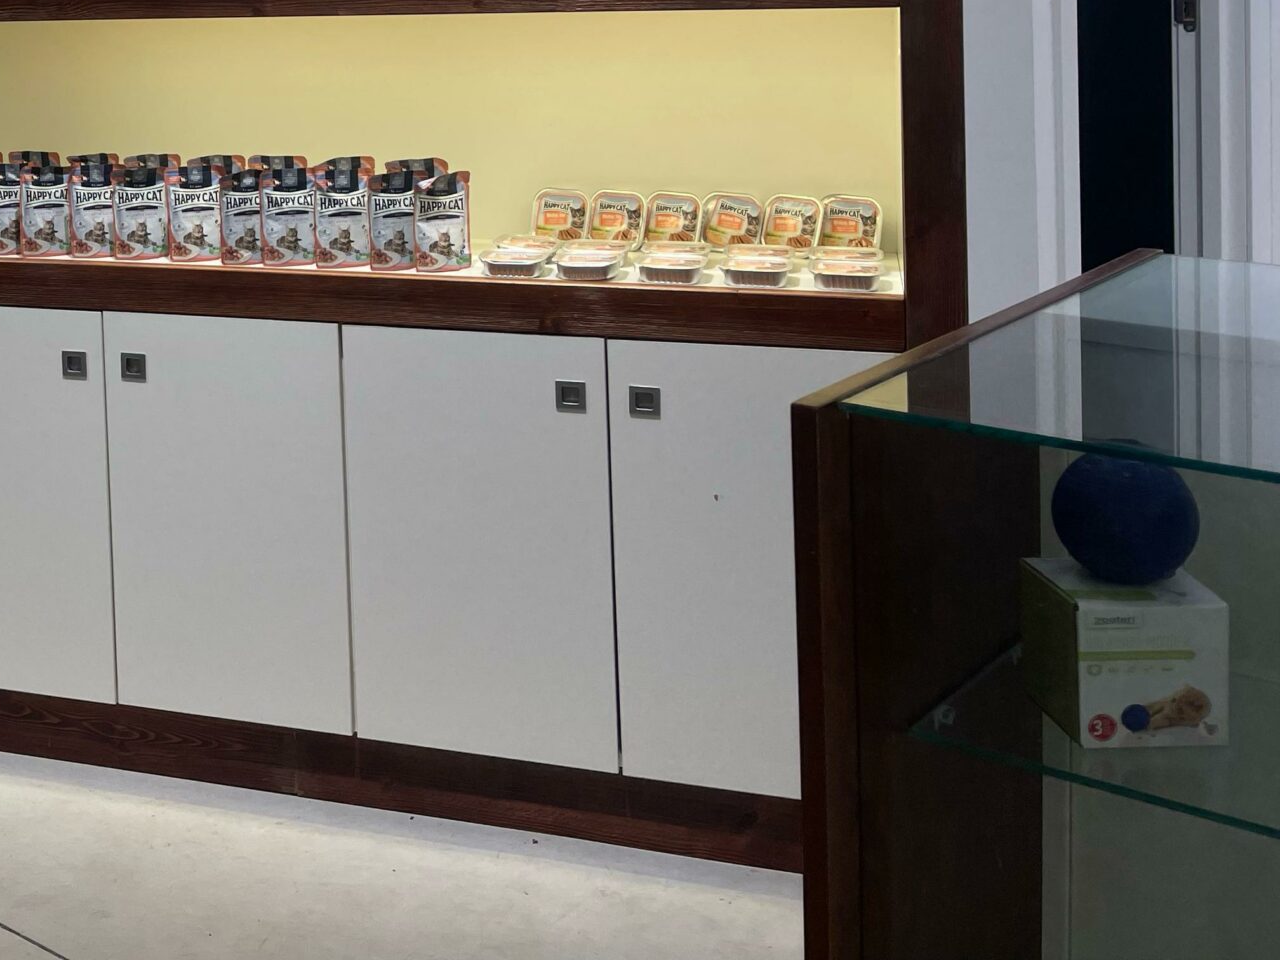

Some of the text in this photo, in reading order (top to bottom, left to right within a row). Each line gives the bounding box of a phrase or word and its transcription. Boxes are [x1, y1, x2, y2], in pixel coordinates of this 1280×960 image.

[26, 190, 53, 202] HAPPY
[76, 191, 102, 204] HAPPY
[118, 190, 162, 204] HAPPY CAT
[174, 191, 218, 206] HAPPY CAT
[226, 196, 254, 210] HAPPY
[266, 196, 296, 209] HAPPY
[297, 194, 314, 206] CAT
[320, 195, 366, 210] HAPPY CAT
[374, 198, 401, 211] HAPPY
[420, 198, 464, 213] HAPPY CAT
